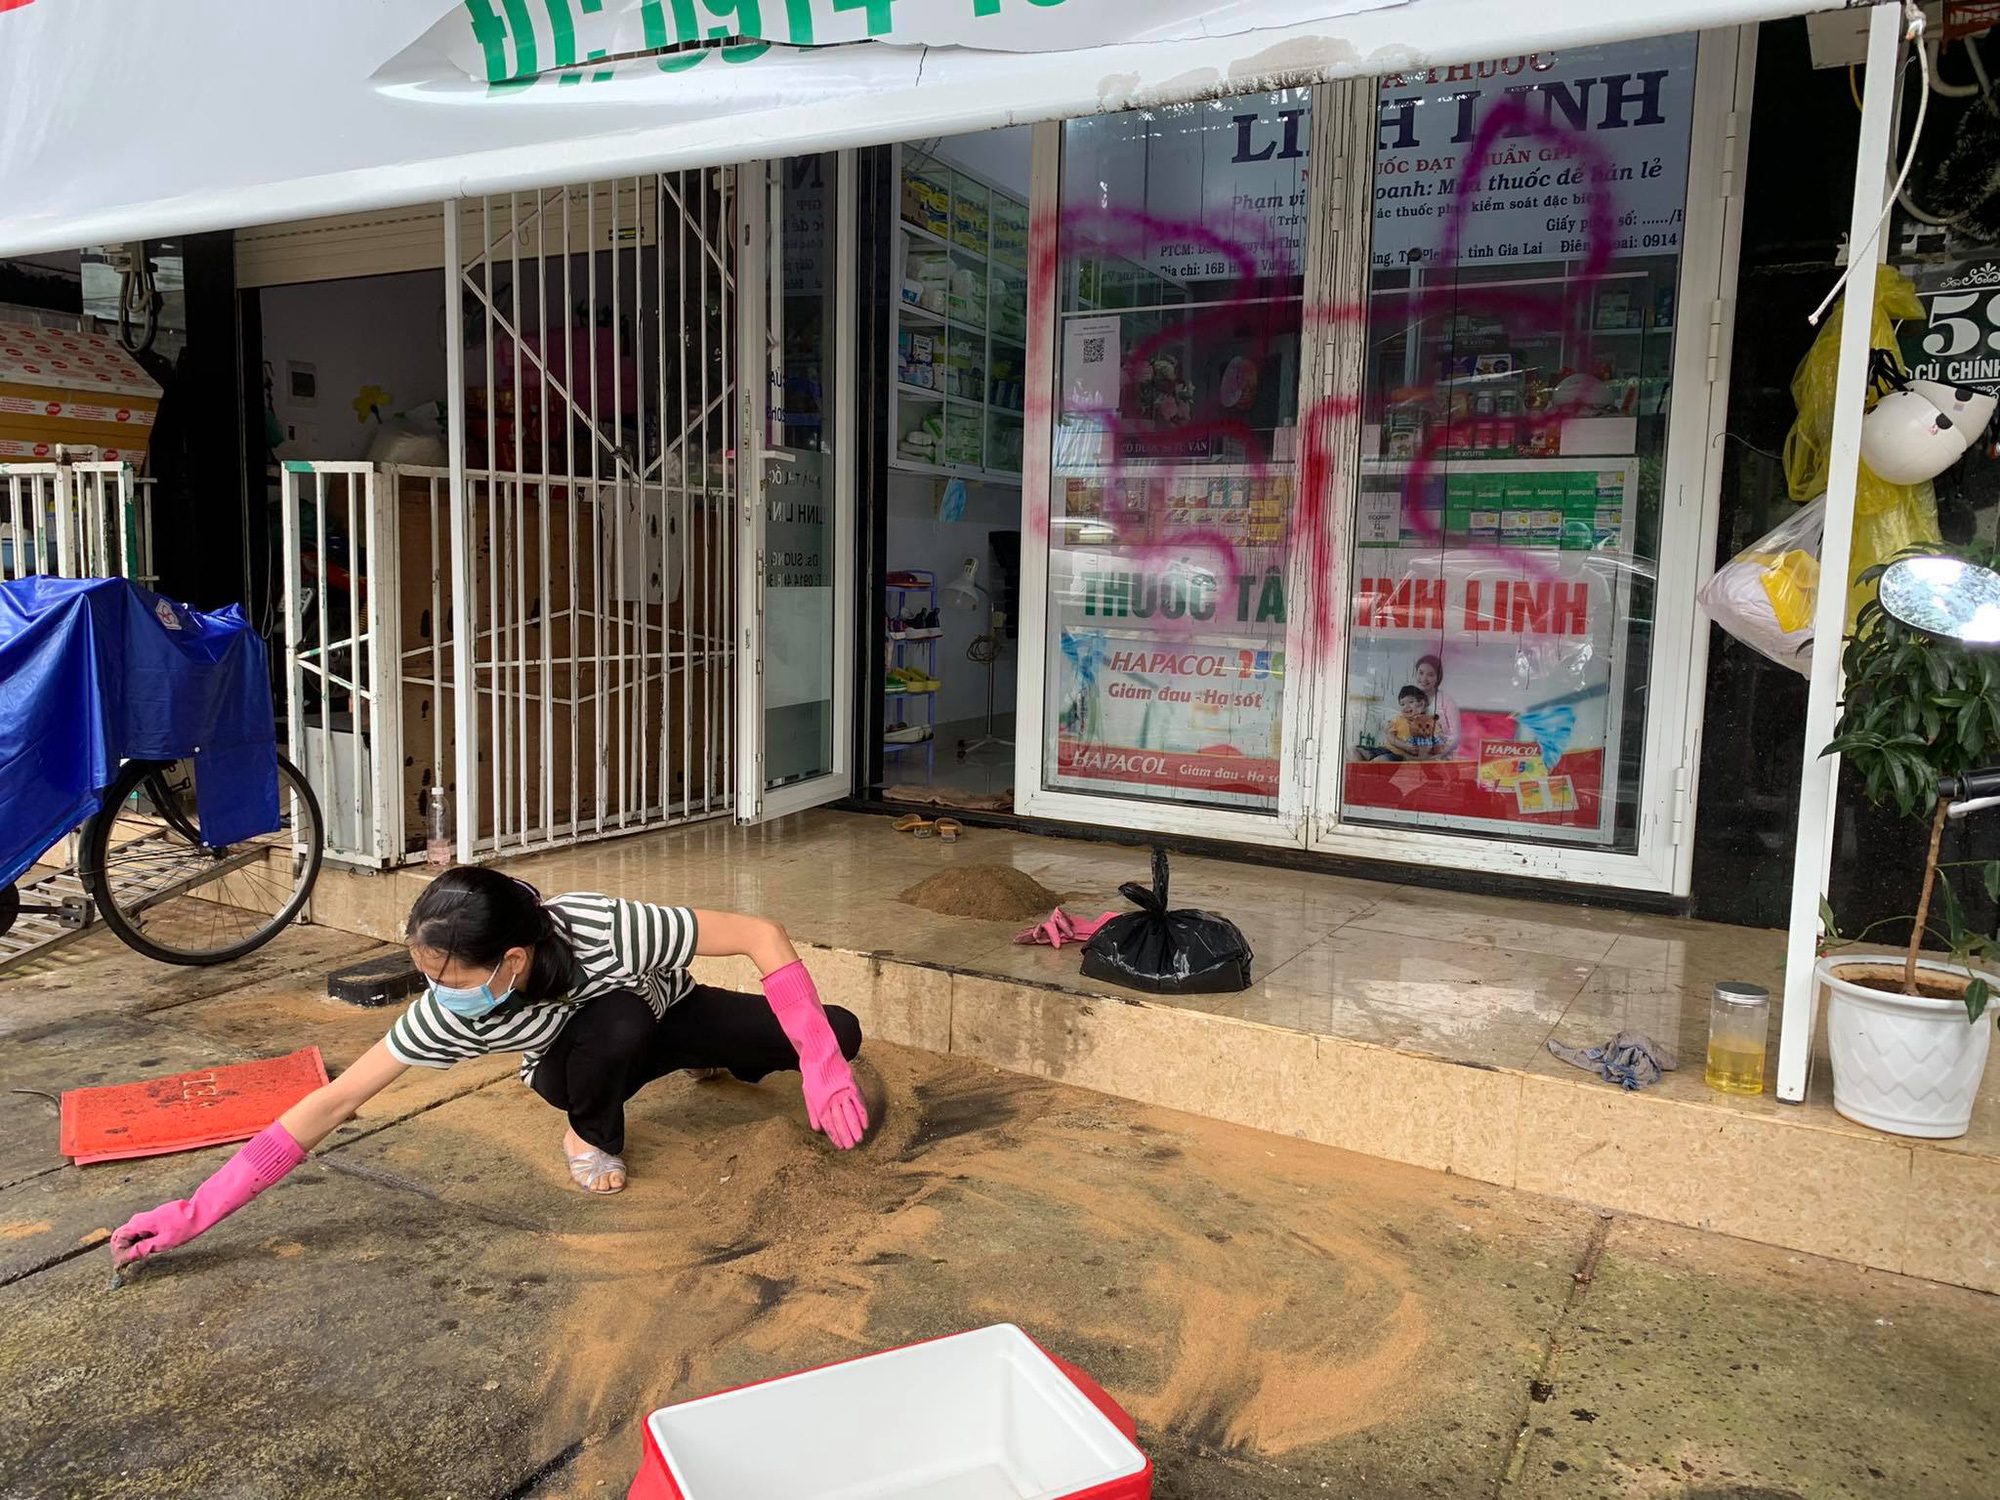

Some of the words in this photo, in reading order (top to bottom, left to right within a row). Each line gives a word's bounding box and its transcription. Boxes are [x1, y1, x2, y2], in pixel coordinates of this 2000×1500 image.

[1416, 157, 1455, 174] ĐẠT
[1463, 144, 1531, 167] UẨN
[1376, 180, 1432, 200] oanh:
[1488, 166, 1550, 191] thuốc
[1641, 157, 1663, 179] lẻ
[1396, 203, 1433, 217] thuốc
[1471, 197, 1504, 212] kiểm
[1510, 196, 1538, 210] soát
[1543, 194, 1568, 209] đặc
[1546, 214, 1576, 233] Giấy
[1205, 262, 1225, 274] 16B
[1498, 244, 1518, 257] Gia
[1523, 242, 1542, 255] Lai
[1643, 233, 1677, 247] 0914
[1922, 292, 2000, 356] 5
[1235, 565, 1287, 623] TÂ
[1353, 577, 1446, 630] INH
[1464, 579, 1588, 635] LINH
[1110, 651, 1228, 678] HAPACOL
[1158, 686, 1191, 703] đau
[1203, 689, 1229, 708] Hạ
[1234, 691, 1263, 708] sốt
[1072, 749, 1168, 776] HAPACOL
[1485, 744, 1539, 756] HAPACOL
